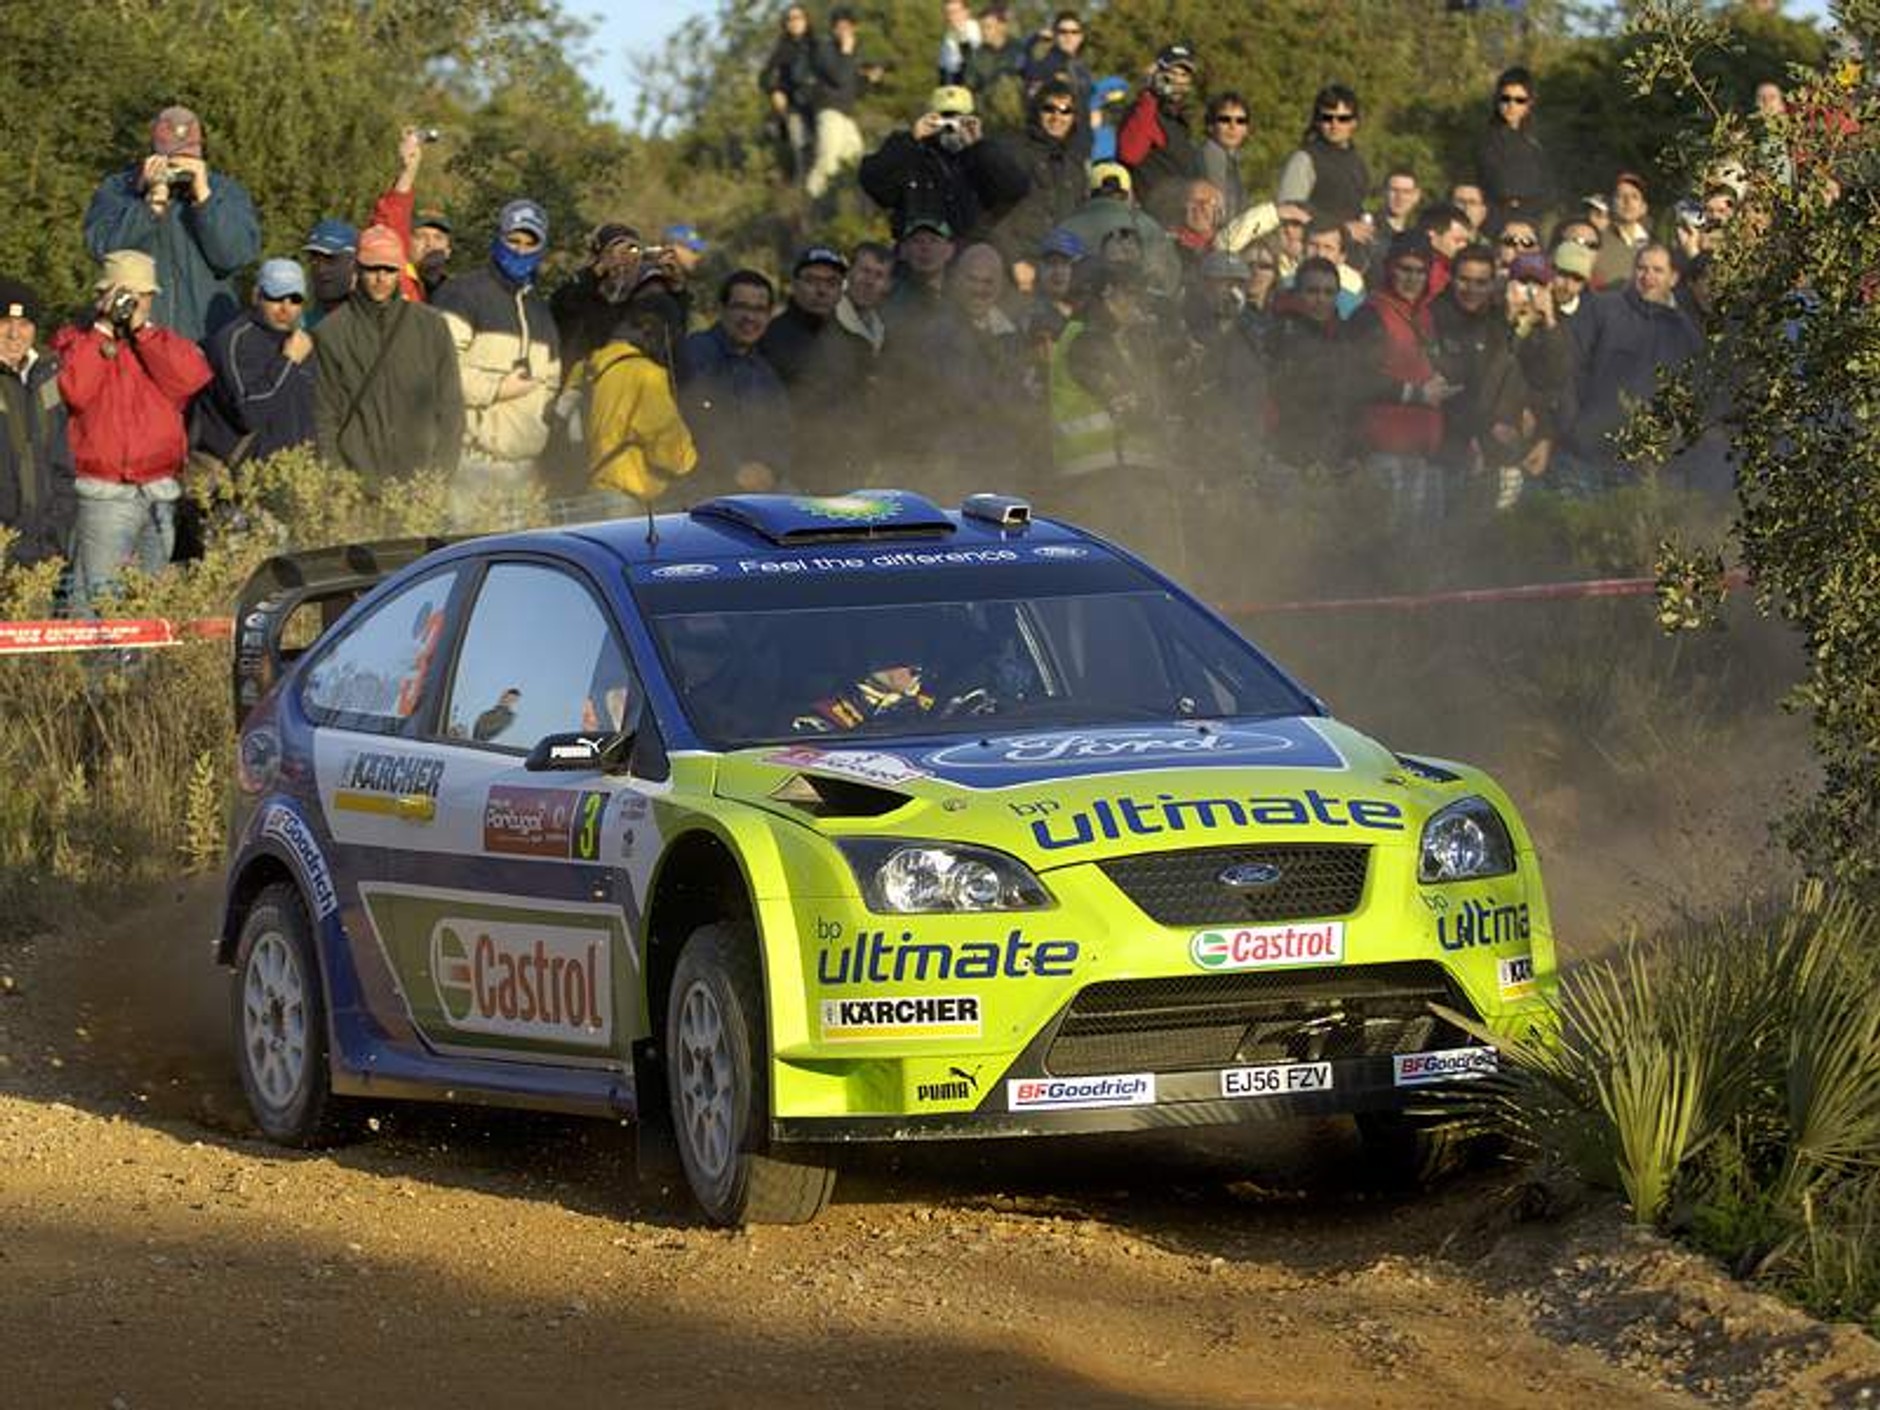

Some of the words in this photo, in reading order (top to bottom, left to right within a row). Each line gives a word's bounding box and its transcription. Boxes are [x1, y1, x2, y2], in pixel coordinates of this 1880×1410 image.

[738, 558, 807, 574] Feel
[813, 556, 865, 571] the
[871, 548, 1018, 568] difference
[1004, 732, 1235, 762] Ford
[1007, 797, 1060, 818] bp
[1030, 789, 1405, 852] ultimate
[580, 793, 602, 858] 3
[818, 918, 842, 944] bp
[1231, 925, 1337, 963] Castrol
[817, 930, 1081, 986] ultimate
[469, 933, 604, 1029] Castrol
[840, 998, 978, 1025] KÄRCHER
[917, 1081, 970, 1101] PUMA
[1017, 1078, 1147, 1100] BFGoodrich
[1225, 1070, 1281, 1094] EJ56
[1286, 1066, 1329, 1089] FZV
